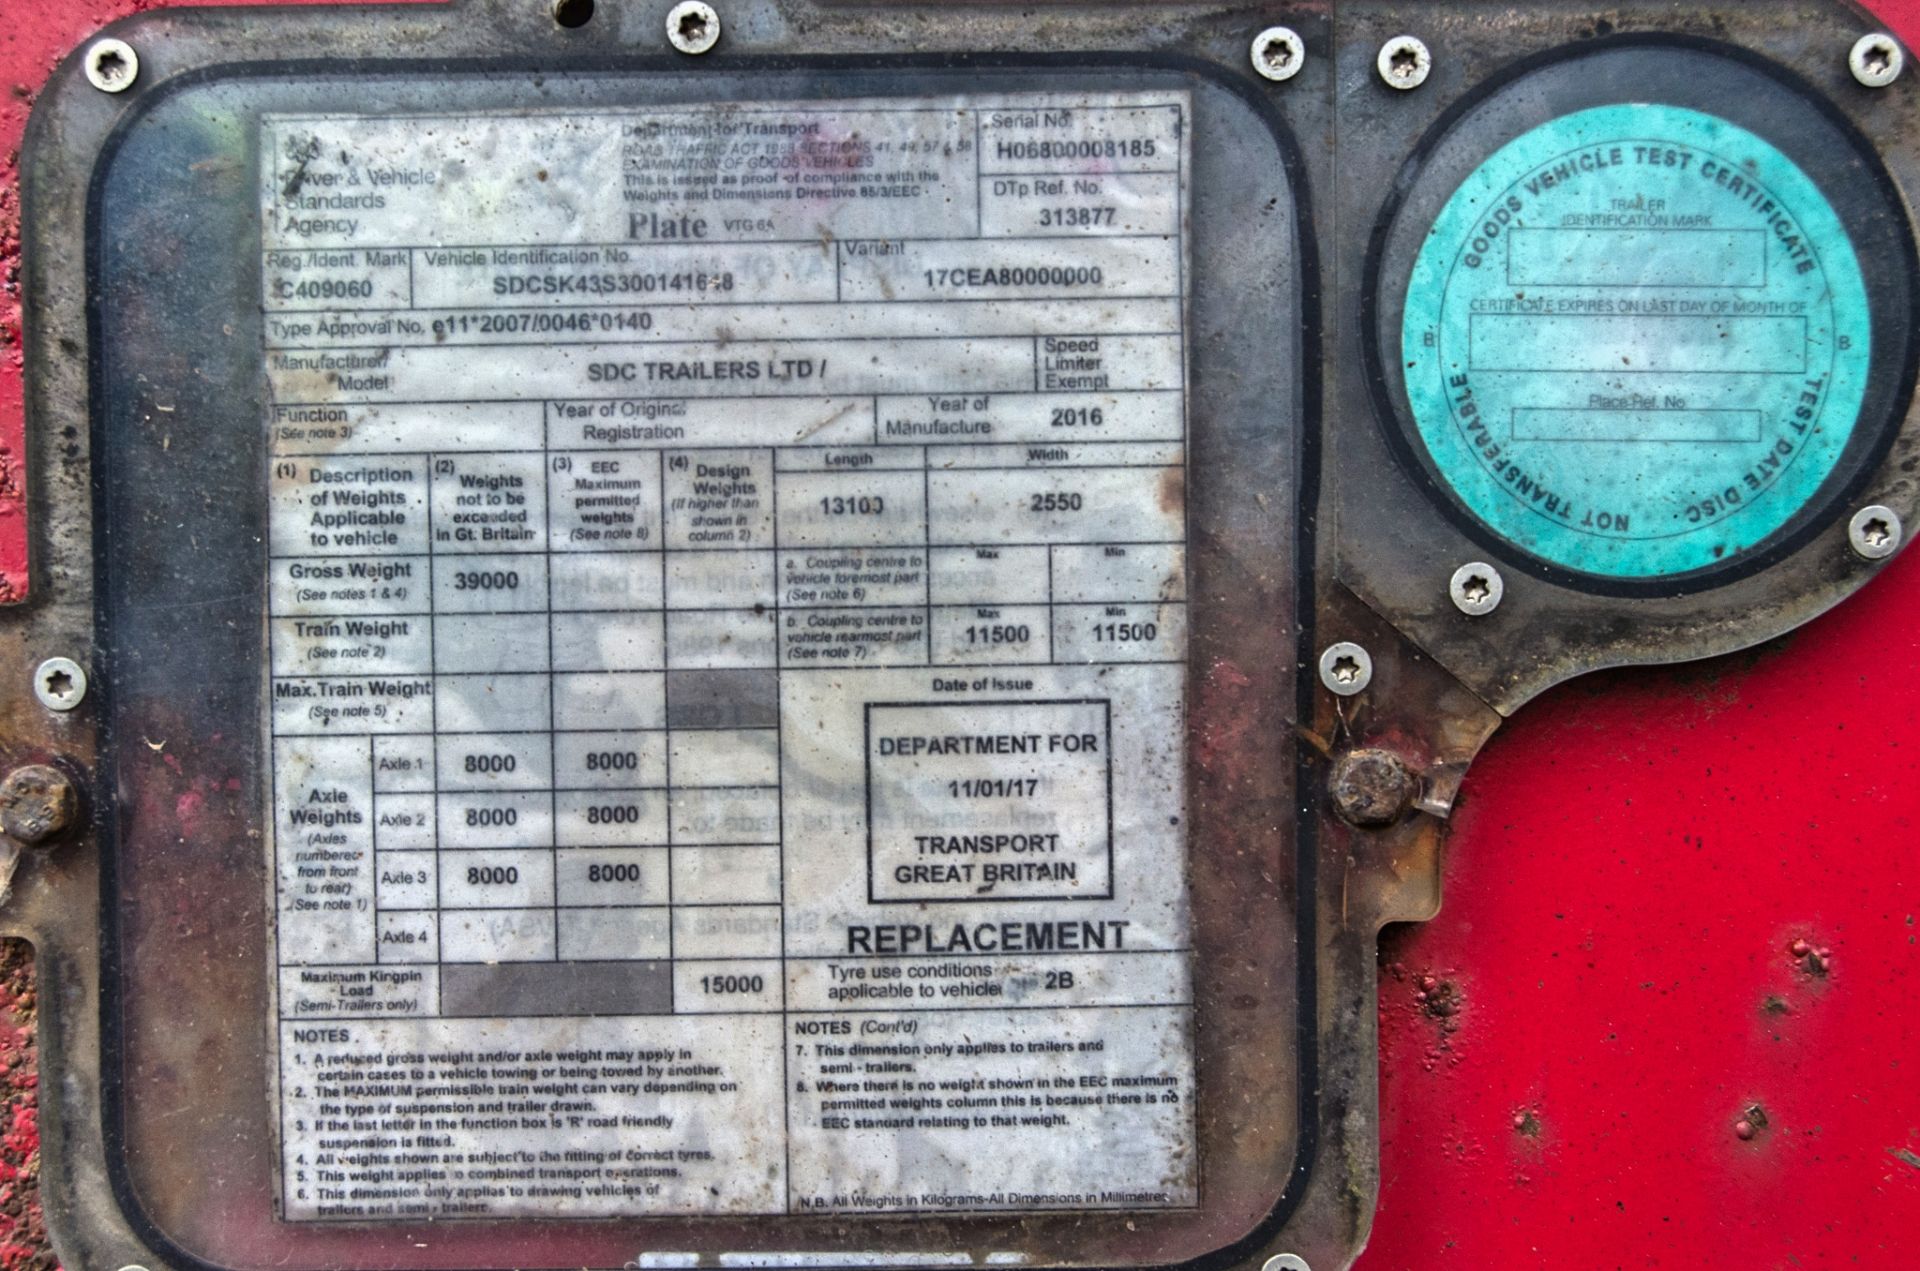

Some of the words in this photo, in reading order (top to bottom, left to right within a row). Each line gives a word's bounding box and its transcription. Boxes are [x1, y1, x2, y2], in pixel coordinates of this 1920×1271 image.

[991, 112, 1037, 129] Serial
[996, 140, 1156, 160] H06800008185
[347, 170, 361, 186] &
[368, 168, 435, 187] Vehicle
[994, 180, 1028, 198] DTp
[1034, 179, 1069, 196] Ref.
[1074, 178, 1102, 195] No.
[1463, 196, 1524, 271] GOODS
[1529, 146, 1624, 196] VEHICLE
[1634, 146, 1693, 166] TEST
[1700, 161, 1817, 275] CERTIFICATE
[1610, 198, 1666, 211] TRAILER
[284, 216, 358, 237] Agency
[1040, 208, 1117, 227] 313877
[1562, 213, 1668, 227] IDENTIFICATION
[1673, 213, 1713, 227] MARK
[628, 214, 708, 240] Plate
[724, 220, 753, 232] VTG
[757, 219, 775, 231] 6A
[846, 240, 906, 256] Variant
[366, 251, 407, 266] Mark
[425, 250, 487, 266] Vehicle
[494, 249, 600, 265] Identification
[605, 249, 632, 264] No.
[925, 267, 1102, 287] 17CEA80000000
[280, 281, 373, 299] C409060
[1469, 299, 1554, 313] CERTIFICATE
[1558, 299, 1614, 313] EXPIRES
[1618, 299, 1640, 313] ON
[1643, 299, 1676, 313] LAST
[1679, 299, 1706, 313] DAY
[1709, 299, 1729, 313] OF
[1732, 299, 1785, 313] MONTH
[1788, 299, 1807, 313] OF
[271, 320, 311, 338] Type
[317, 319, 391, 337] Approval
[397, 318, 425, 335] No.
[1044, 337, 1099, 357] Speed
[1424, 333, 1435, 347] B
[1838, 336, 1850, 349] B
[588, 363, 636, 382] SDC
[768, 358, 813, 379] LTD
[818, 357, 827, 379] /
[1044, 356, 1102, 372] Limiter
[338, 375, 390, 391] Model
[1045, 372, 1110, 391] Exempt
[554, 402, 594, 418] Year
[600, 401, 616, 417] of
[929, 397, 964, 412] Year
[970, 397, 990, 411] of
[1589, 394, 1628, 409] Place
[1632, 394, 1660, 409] Ref.
[1799, 377, 1825, 438] TEST
[276, 406, 348, 423] Function
[1051, 408, 1103, 427] 2016
[584, 424, 685, 442] Registration
[886, 419, 991, 436] Manufacture
[1029, 448, 1070, 462] Width
[1450, 372, 1571, 520] TRANSFERABLE
[435, 459, 455, 475] (2)
[591, 460, 620, 474] EEC
[825, 453, 873, 467] Length
[1743, 439, 1794, 493] DATE
[276, 463, 297, 479] (1)
[310, 467, 413, 486] Description
[459, 474, 524, 490] Weights
[575, 477, 641, 491] Maximum
[311, 491, 328, 506] of
[333, 490, 406, 508] Weights
[456, 492, 480, 506] not
[485, 492, 498, 505] to
[501, 491, 525, 505] be
[575, 494, 641, 510] permitted
[1031, 493, 1082, 512] 2550
[1686, 484, 1743, 524] DISC
[311, 509, 406, 528] Applicable
[580, 510, 634, 526] weights
[1581, 505, 1630, 532] NOT
[311, 530, 328, 545] to
[333, 528, 398, 545] vehicle
[289, 563, 344, 580] Gross
[348, 562, 412, 581] Weight
[455, 572, 519, 590] 39000
[1105, 607, 1127, 618] Min
[295, 621, 341, 637] Train
[346, 621, 408, 640] Weight
[965, 626, 1030, 644] 11500
[1092, 623, 1157, 642] 11500
[276, 682, 366, 699] Max.Train
[369, 681, 431, 698] Weight
[932, 678, 967, 692] Date
[973, 678, 988, 691] of
[993, 678, 1034, 692] Issue
[880, 735, 1041, 757] DEPARTMENT
[1048, 733, 1098, 754] FOR
[378, 757, 411, 772] Axle
[415, 757, 423, 771] 1
[464, 754, 516, 774] 8000
[586, 752, 638, 771] 8000
[308, 788, 348, 803] Axle
[948, 779, 1038, 799] 11/01/17
[290, 808, 362, 826] Weights
[380, 812, 411, 827] Axle
[415, 812, 425, 826] 2
[466, 808, 517, 827] 8000
[587, 806, 639, 825] 8000
[914, 834, 1060, 855] TRANSPORT
[381, 869, 413, 885] Axle
[416, 869, 427, 884] 3
[467, 866, 519, 885] 8000
[588, 864, 640, 883] 8000
[894, 863, 976, 884] GREAT
[982, 862, 1076, 883] BRITAIN
[382, 930, 413, 945] Axle
[416, 929, 428, 944] 4
[847, 921, 1130, 954] REPLACEMENT
[300, 969, 366, 984] Maximum
[370, 969, 423, 986] Kingpin
[828, 964, 866, 981] Tyre
[871, 965, 901, 979] use
[907, 962, 993, 979] conditions
[700, 974, 763, 994] 15000
[828, 982, 914, 1000] applicable
[919, 982, 935, 997] to
[940, 980, 1001, 998] vehicle
[1044, 972, 1074, 990] 2B
[339, 984, 374, 998] Load
[294, 1028, 350, 1044] NOTES
[795, 1022, 852, 1036] NOTES
[860, 1020, 918, 1037] (Cont'd)
[797, 1046, 808, 1057] 7.
[815, 1044, 845, 1057] This
[849, 1042, 921, 1056] dimension
[924, 1042, 954, 1058] only
[1010, 1041, 1024, 1053] to
[1027, 1040, 1074, 1053] trailers
[1078, 1039, 1104, 1052] and
